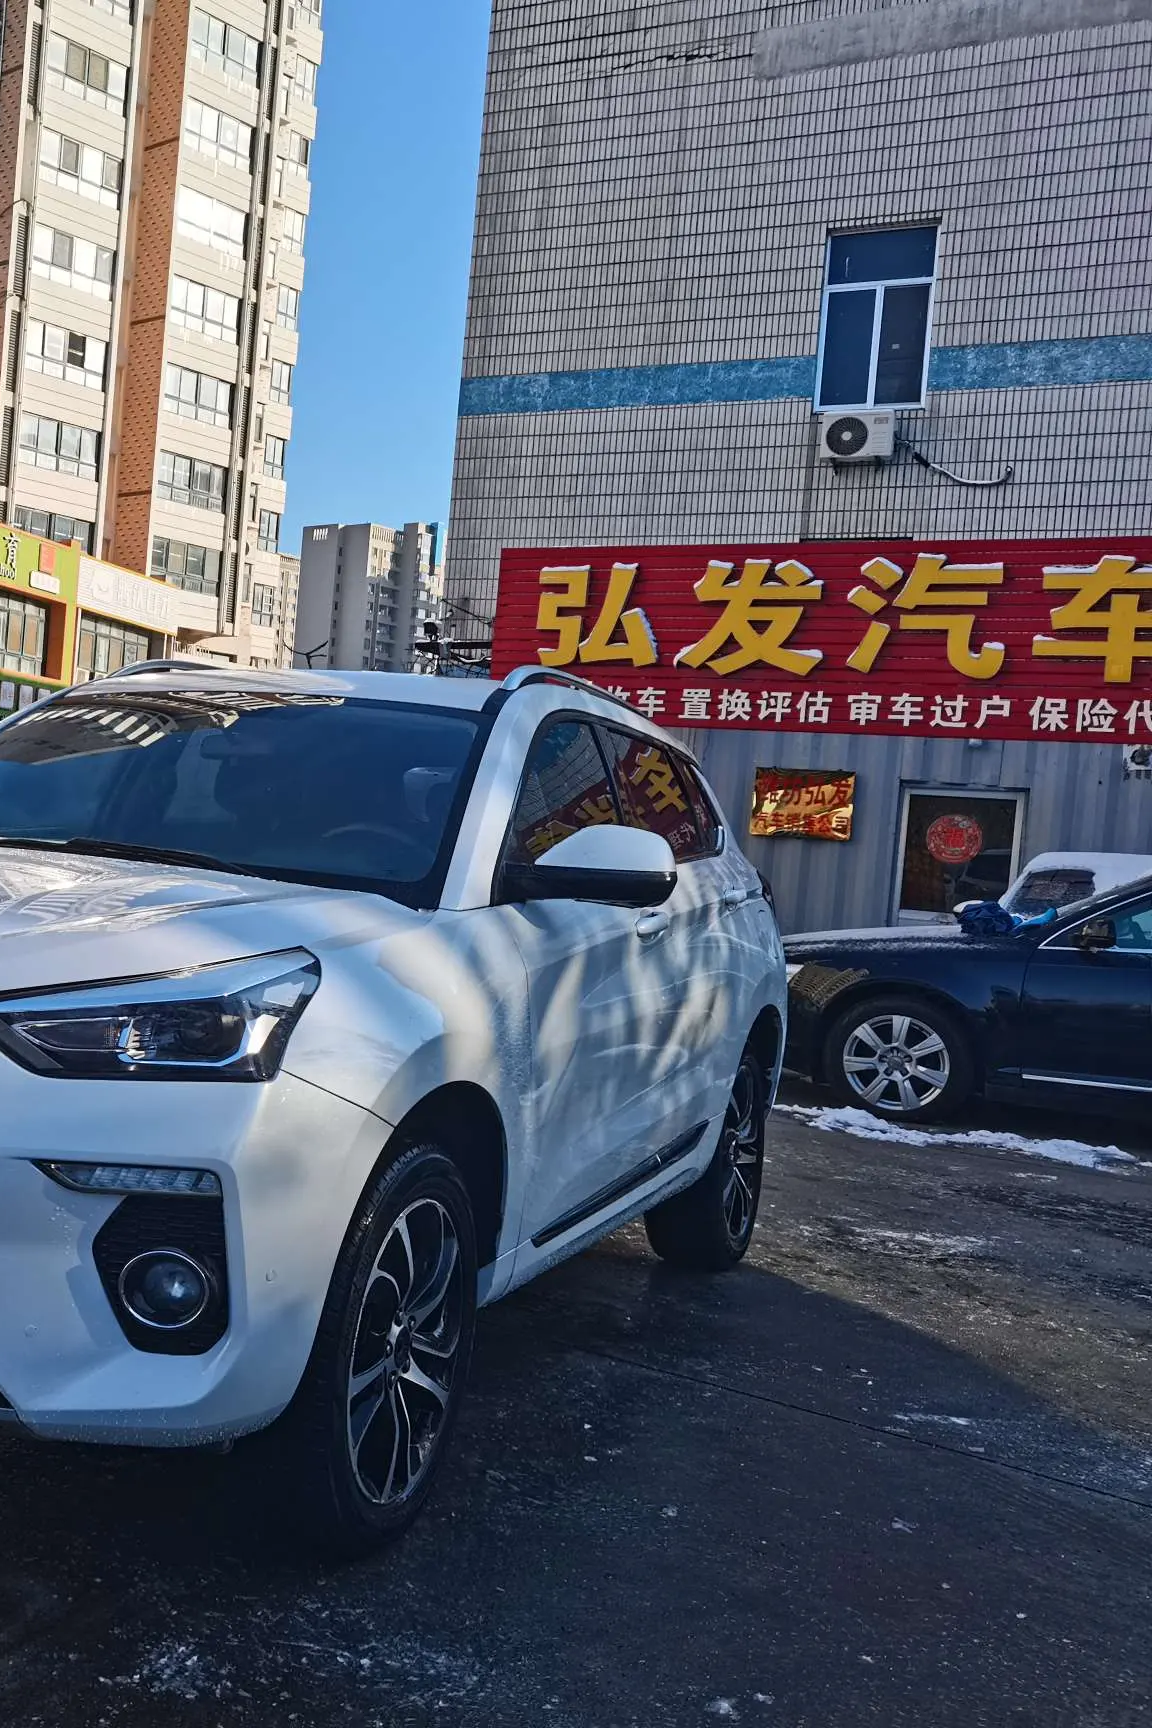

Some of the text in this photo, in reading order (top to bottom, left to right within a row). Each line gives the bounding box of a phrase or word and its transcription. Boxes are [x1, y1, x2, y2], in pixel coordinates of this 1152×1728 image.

[536, 552, 1152, 684] 弘发汽车
[677, 688, 833, 725] 置换评估
[847, 691, 1011, 729] 审车过户
